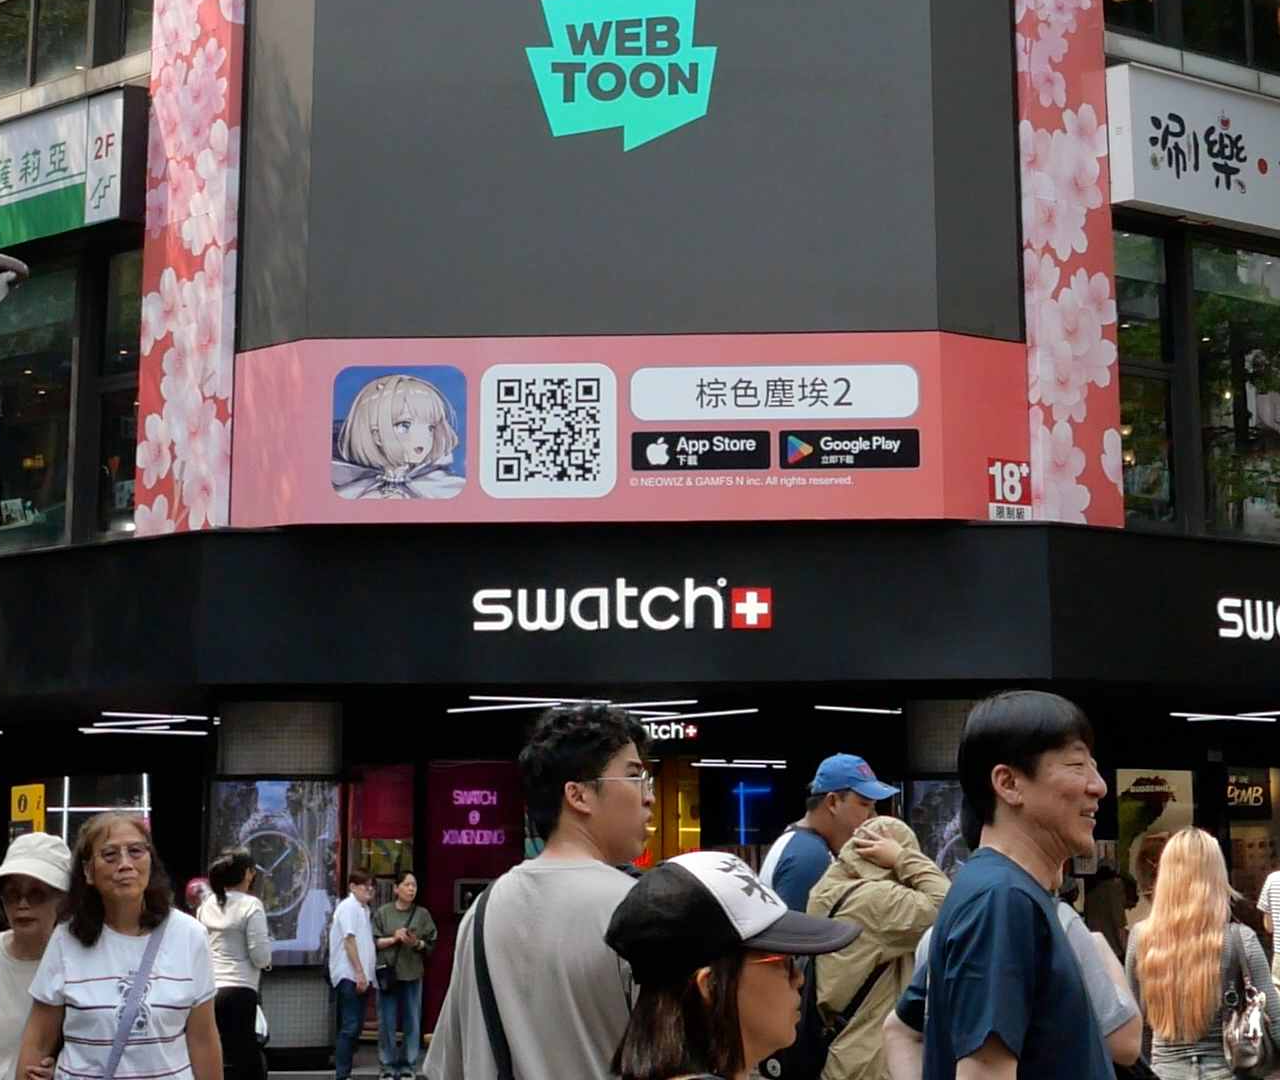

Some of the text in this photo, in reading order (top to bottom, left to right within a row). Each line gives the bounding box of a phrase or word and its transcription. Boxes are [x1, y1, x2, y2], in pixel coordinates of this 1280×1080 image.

[565, 16, 680, 56] WEB
[551, 62, 699, 103] TOON
[93, 132, 117, 162] 2F
[695, 376, 854, 410] 棕色塵埃2
[676, 436, 756, 454] App Store
[820, 436, 901, 455] Google Play
[640, 476, 684, 487] NEOWIZ
[765, 475, 779, 486] All
[780, 475, 807, 487] rights
[471, 576, 720, 632] swatch
[452, 789, 497, 806] SWATCH
